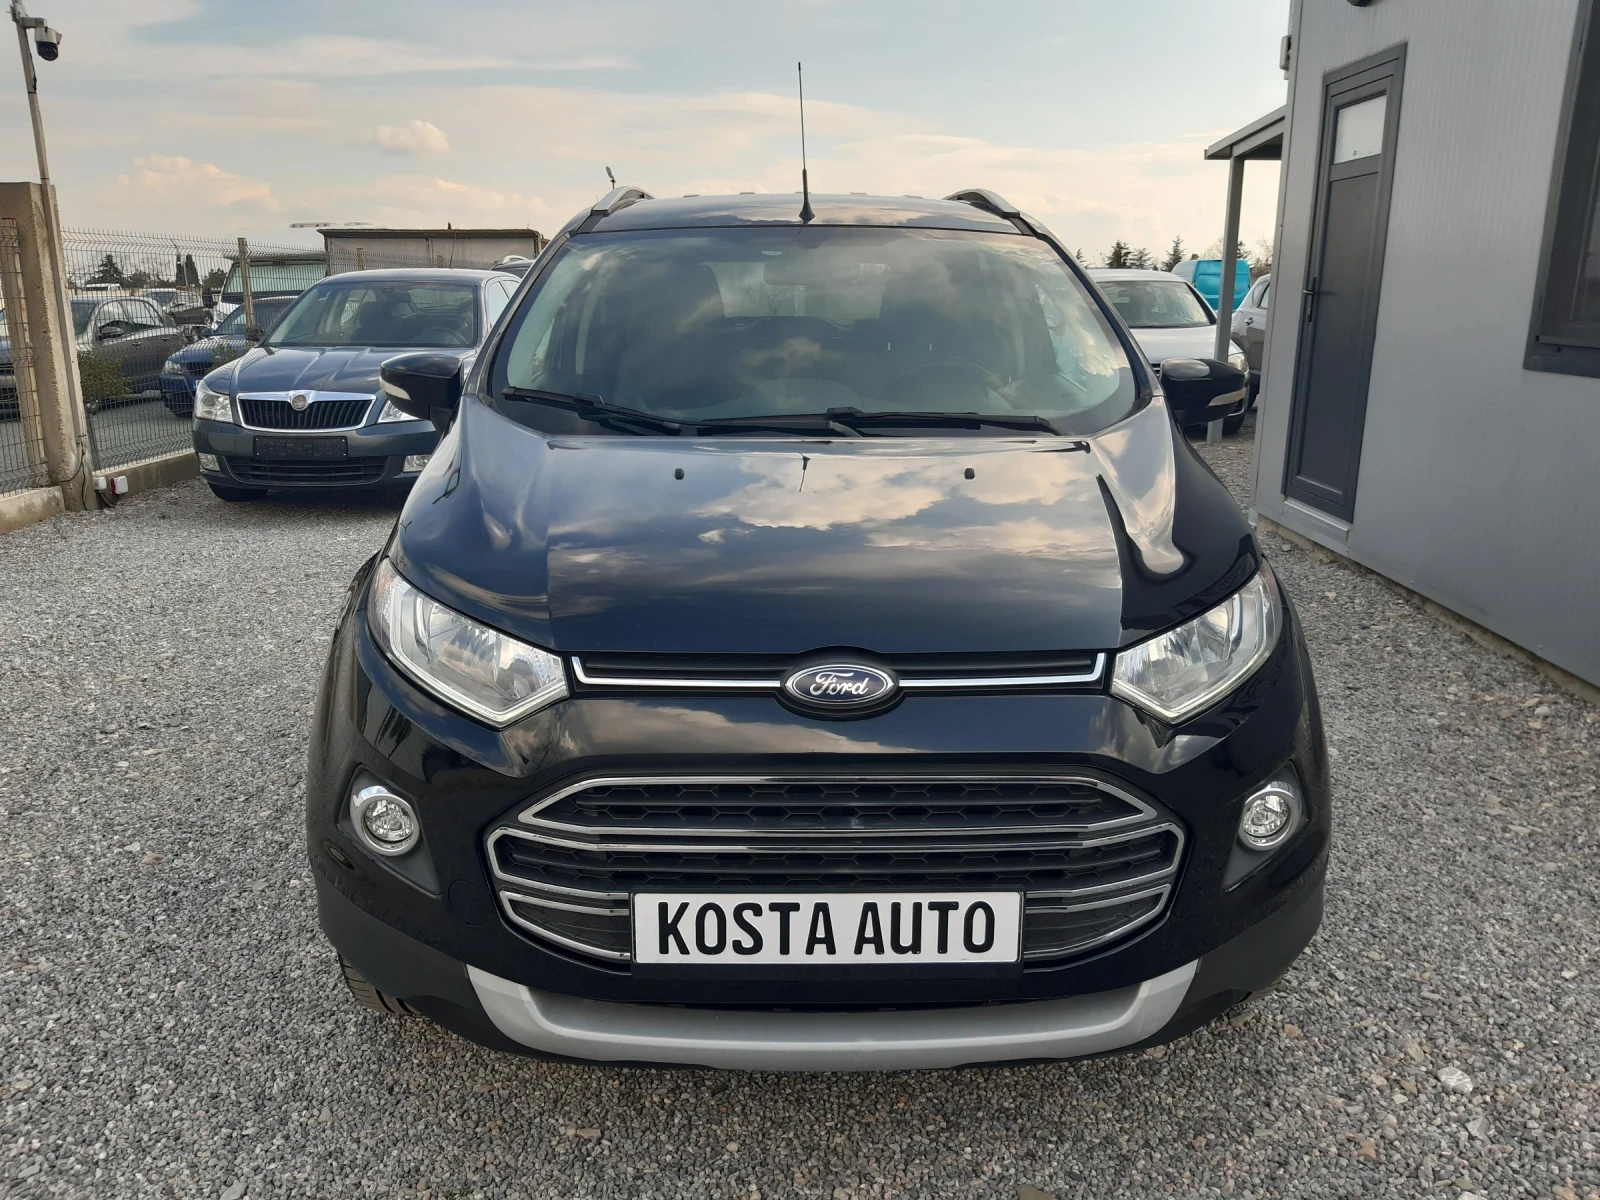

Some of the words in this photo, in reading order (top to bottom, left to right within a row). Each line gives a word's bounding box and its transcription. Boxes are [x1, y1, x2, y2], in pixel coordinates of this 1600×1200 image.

[809, 671, 870, 696] Ford
[658, 902, 837, 955] KOSTA
[853, 901, 995, 954] AUTO
